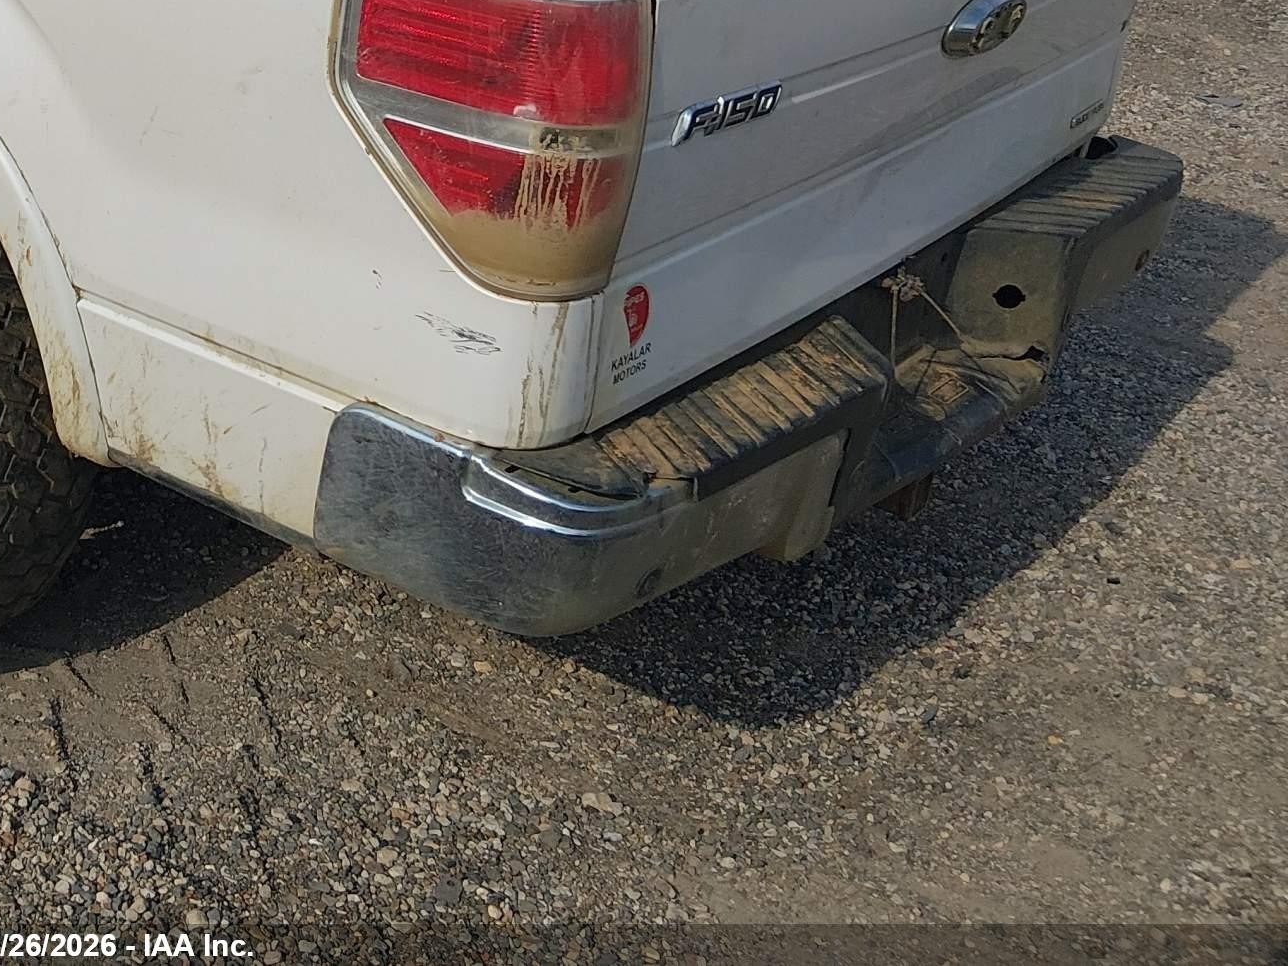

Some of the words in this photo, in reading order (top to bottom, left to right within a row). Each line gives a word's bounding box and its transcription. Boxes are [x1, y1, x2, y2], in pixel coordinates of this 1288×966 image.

[671, 82, 783, 147] F-150
[611, 342, 652, 372] KAYALAR
[613, 359, 647, 385] MOTORS
